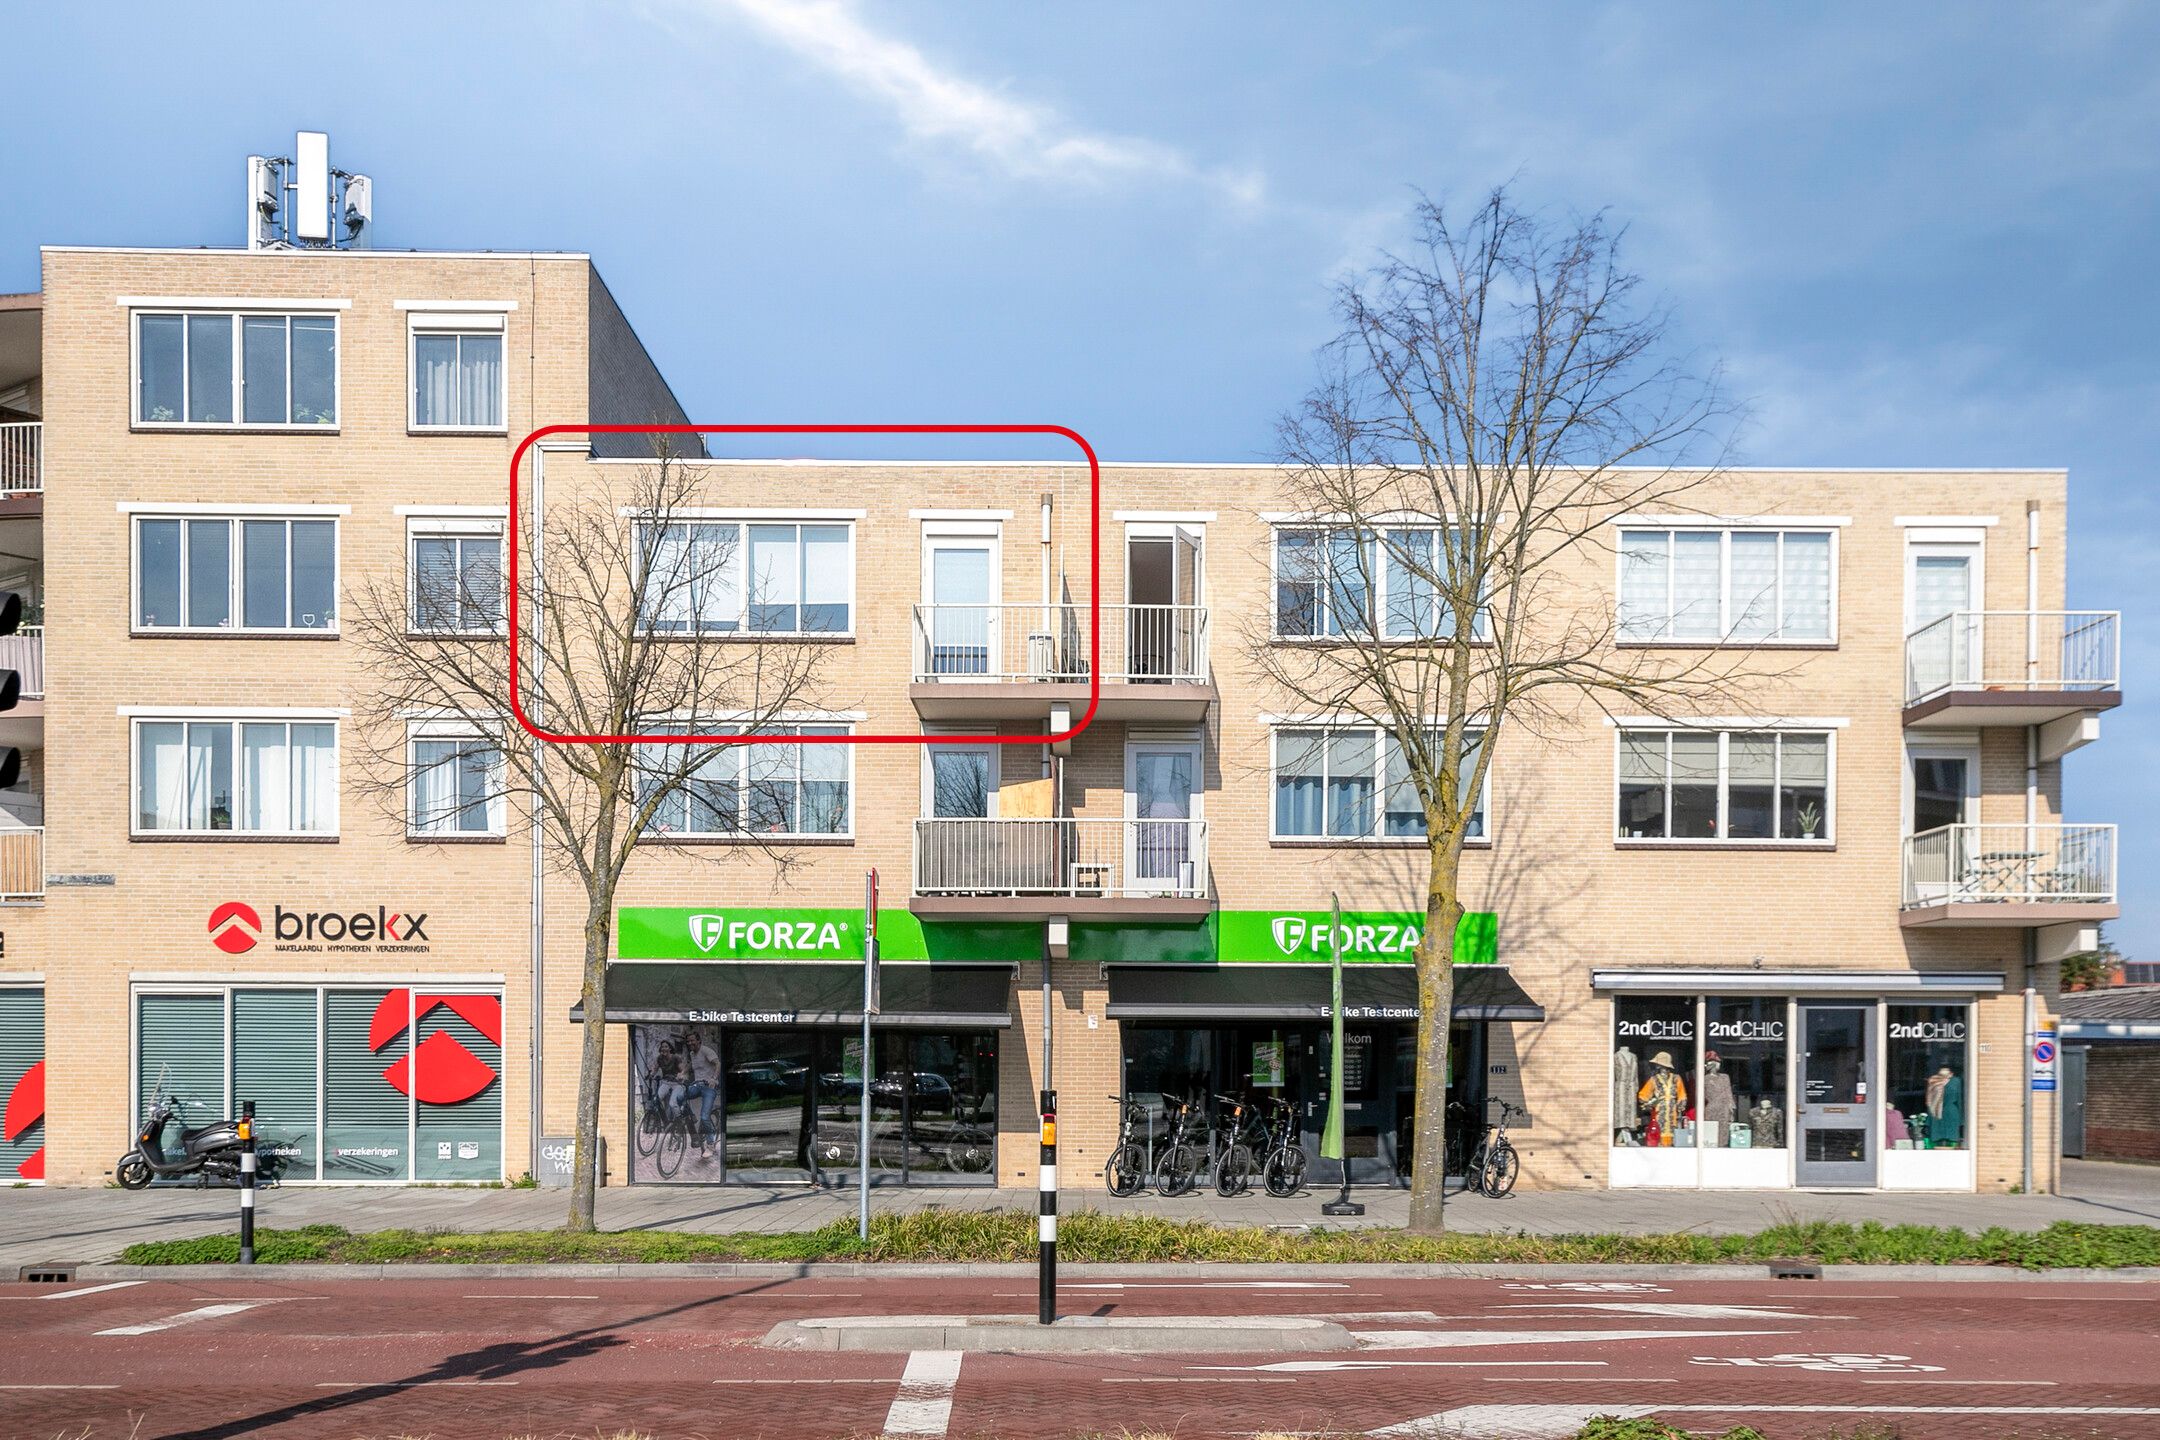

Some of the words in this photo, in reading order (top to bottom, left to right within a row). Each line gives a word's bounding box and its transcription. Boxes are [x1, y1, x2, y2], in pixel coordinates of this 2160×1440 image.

[275, 904, 429, 941] broekx
[1311, 924, 1426, 953] FORZA
[327, 945, 372, 953] HYPOTHEKEN
[375, 945, 430, 953] VERZEKERINGEN
[688, 1011, 728, 1022] E-bike
[730, 1011, 795, 1023] Testcenter
[1320, 1006, 1360, 1017] E-ike
[1361, 1006, 1420, 1017] Testcente
[1618, 1019, 1693, 1037] 2ndCHIC
[1708, 1020, 1784, 1038] 2ndCHIC
[1889, 1021, 1966, 1039] 2ndCHIC
[1326, 1032, 1372, 1044] Wlkom
[338, 1147, 399, 1158] verzekeringen
